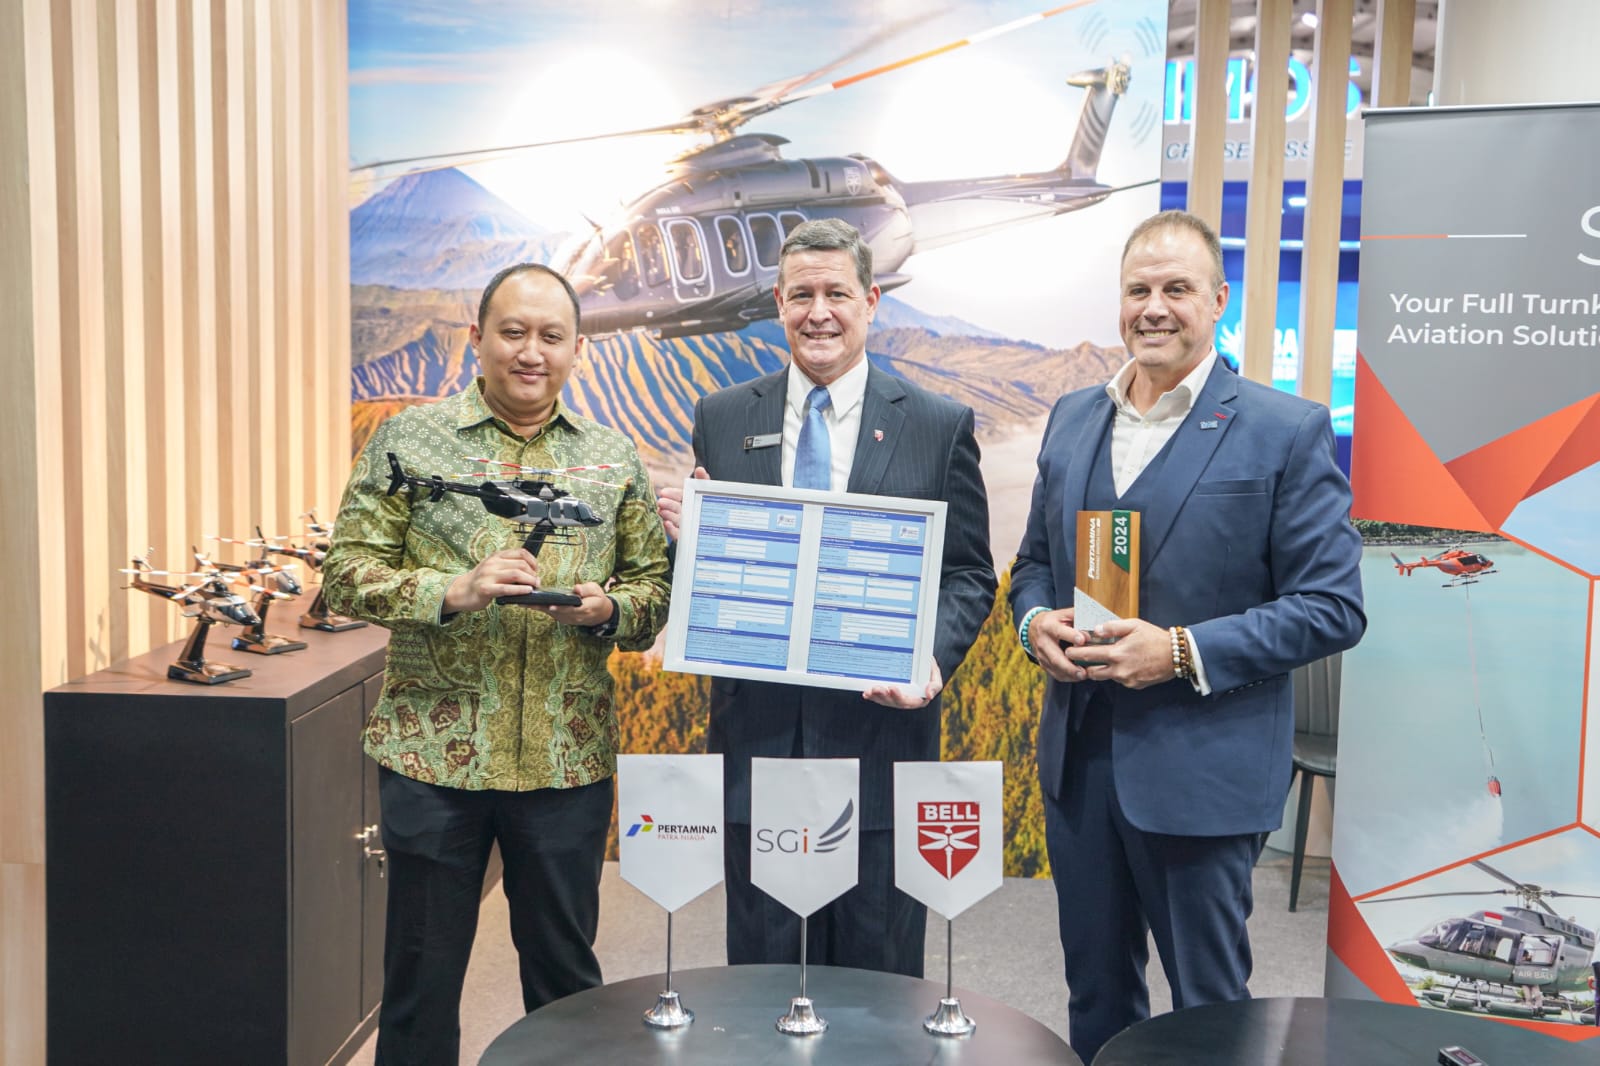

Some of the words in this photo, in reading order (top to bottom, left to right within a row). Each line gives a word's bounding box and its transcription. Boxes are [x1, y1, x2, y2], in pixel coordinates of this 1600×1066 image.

[1389, 293, 1454, 314] Your
[1462, 293, 1514, 314] Full
[1387, 323, 1504, 345] Aviation
[1512, 324, 1600, 346] Soluti
[1115, 517, 1128, 555] 2024
[923, 805, 978, 821] BELL
[657, 824, 718, 834] PERTAMINA
[756, 828, 807, 853] SGi
